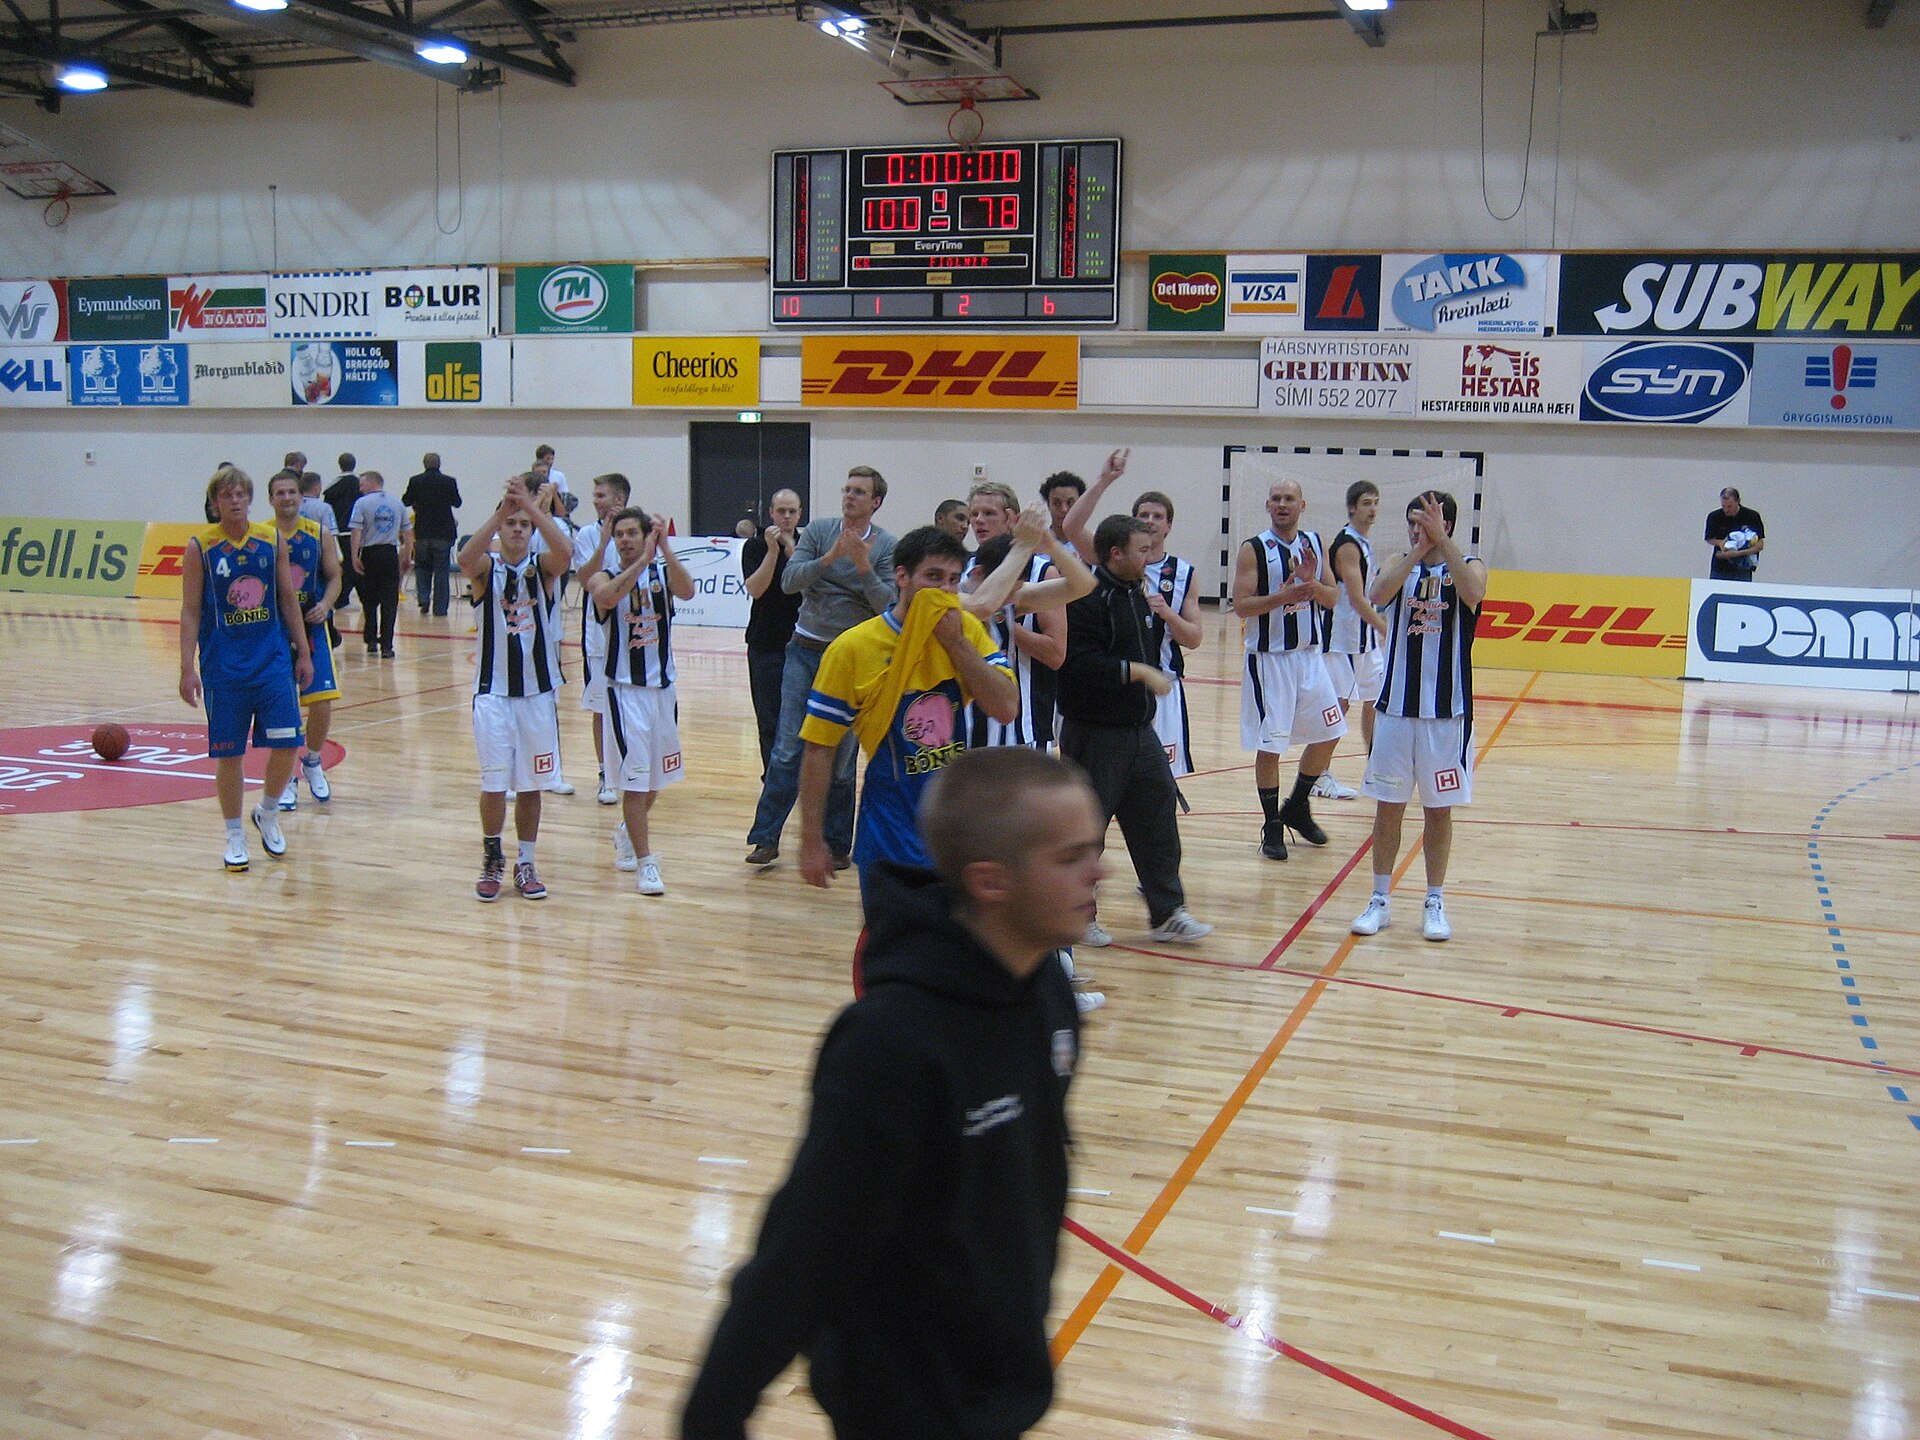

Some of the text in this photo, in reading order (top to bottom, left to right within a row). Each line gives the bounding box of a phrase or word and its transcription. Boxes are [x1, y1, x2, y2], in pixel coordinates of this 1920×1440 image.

[934, 191, 946, 209] 4
[978, 196, 1017, 228] 78
[865, 199, 919, 230] 100
[914, 240, 963, 251] EveryTime
[553, 276, 590, 302] TM
[1157, 282, 1217, 296] Del Monte
[1404, 257, 1505, 302] TAKK
[78, 295, 161, 315] Eymundsson
[274, 291, 370, 318] SINDRI
[385, 284, 481, 309] BOLUR
[875, 296, 881, 314] 1
[957, 294, 971, 316] 2
[1043, 295, 1056, 315] 6
[1241, 285, 1287, 301] VISA
[1594, 263, 1920, 334] SUBWAY
[204, 310, 266, 325] NÓATÚN
[782, 297, 799, 316] 10
[1438, 292, 1512, 323] hreinlæti
[345, 347, 381, 357] HOLL OG
[1266, 342, 1409, 357] HÁRSNYRTISTOFAN
[653, 350, 738, 378] Cheerios
[829, 350, 1061, 396] DHL
[1264, 360, 1413, 382] GREIFINN
[1522, 351, 1540, 376] ÍS
[427, 362, 480, 401] olís
[1461, 377, 1540, 398] HESTAR
[1600, 364, 1725, 396] sýn
[1275, 383, 1398, 408] SÍMI 552 2077
[1512, 402, 1544, 414] ALLRA
[1547, 402, 1574, 414] HÆFI
[2, 527, 128, 581] fell.is
[216, 557, 232, 578] 4
[1419, 575, 1440, 600] 10
[1473, 599, 1664, 648] DHL
[904, 741, 965, 775] BÓN
